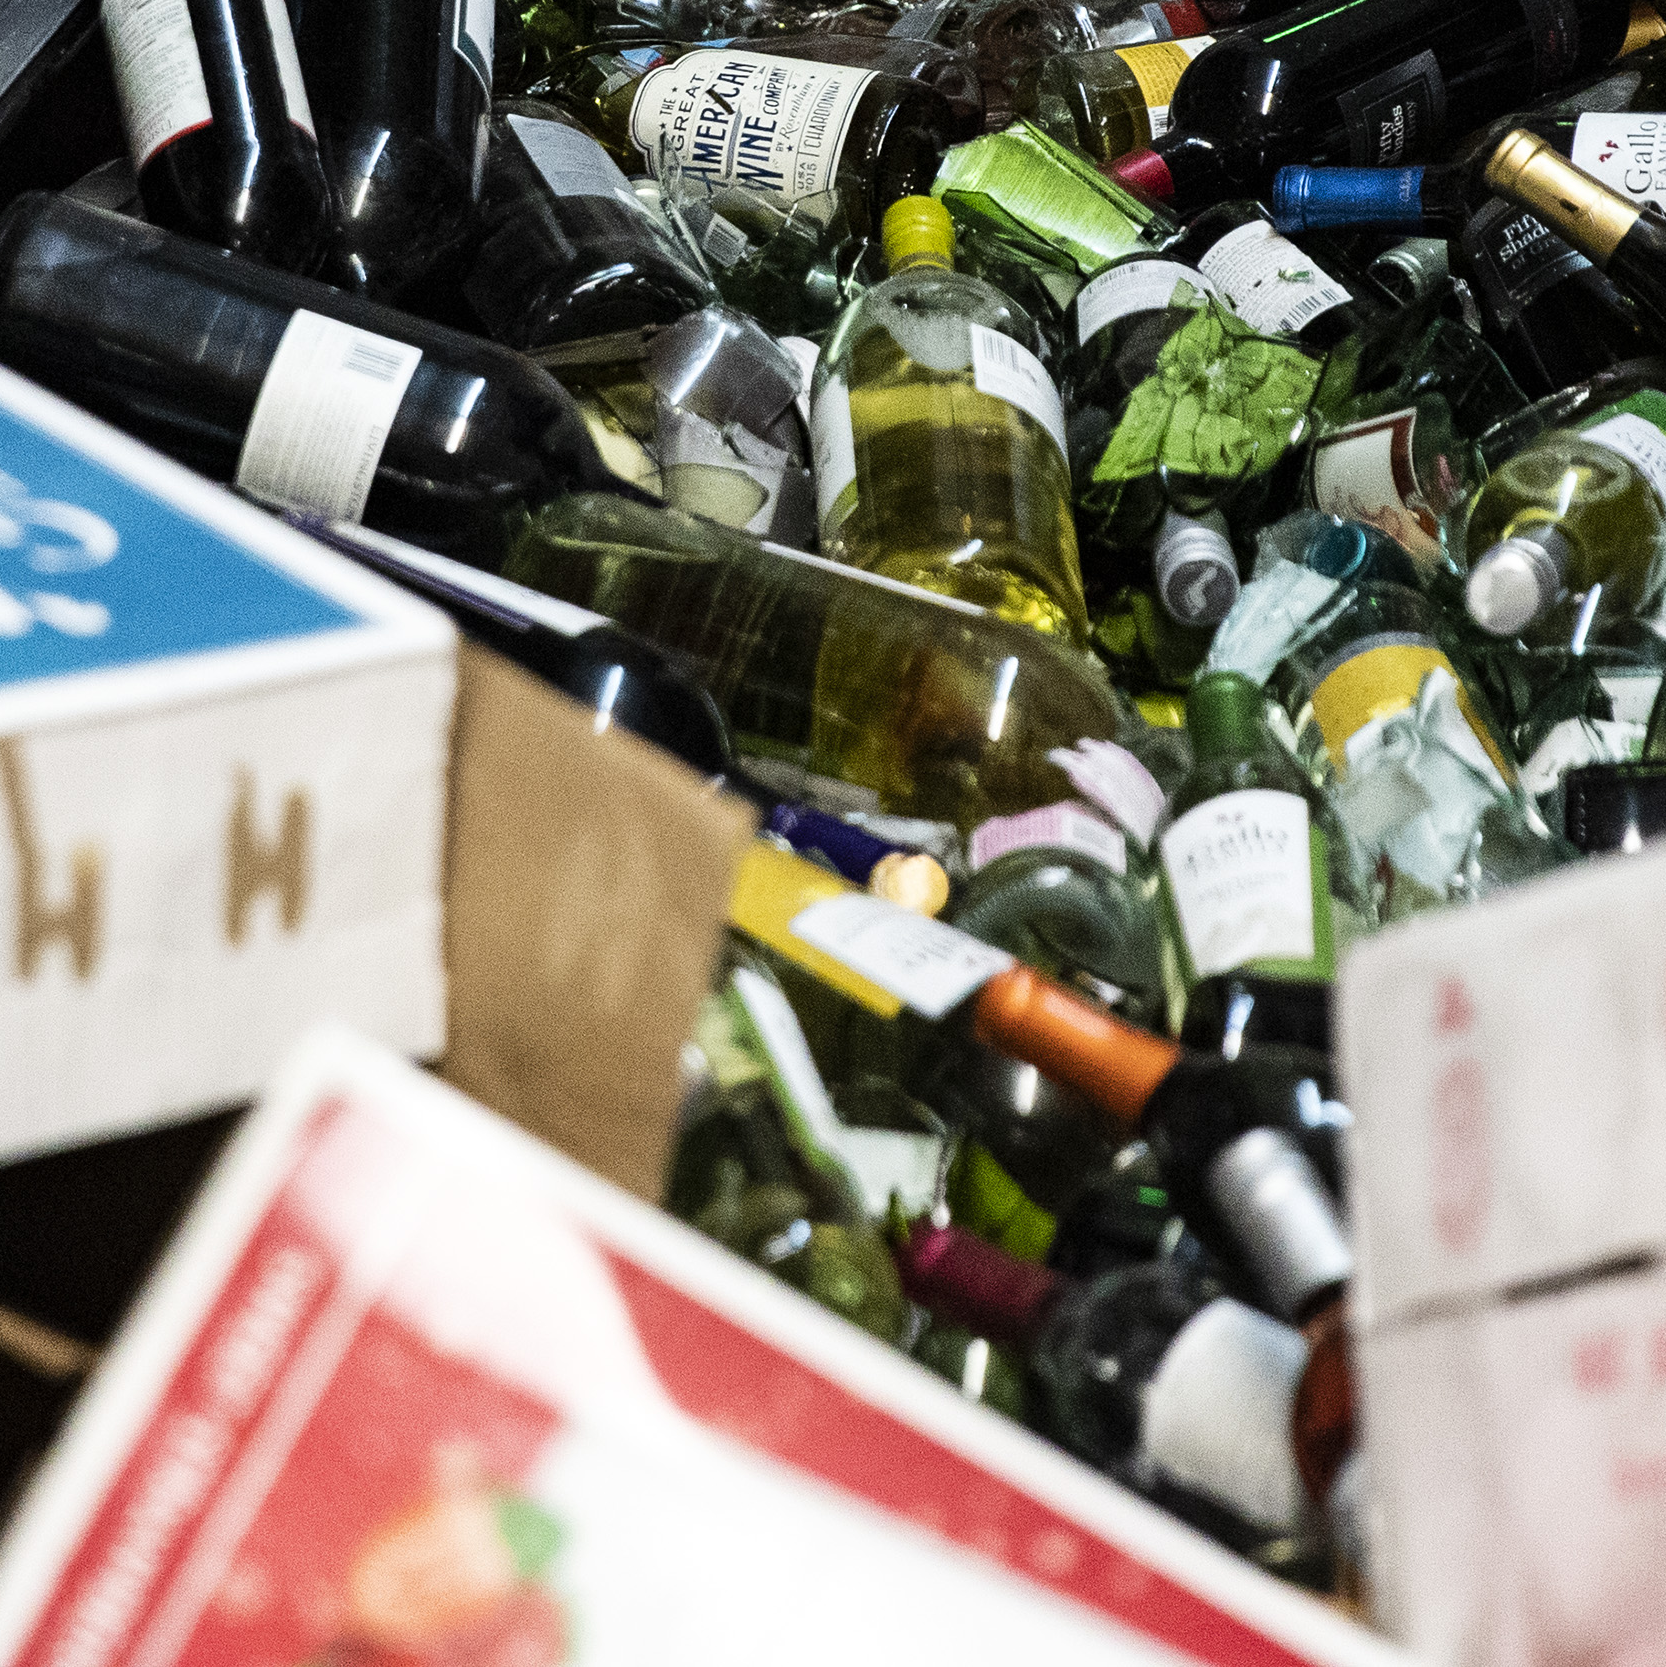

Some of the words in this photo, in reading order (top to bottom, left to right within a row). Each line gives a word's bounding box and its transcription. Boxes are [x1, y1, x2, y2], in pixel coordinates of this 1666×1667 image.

[659, 98, 676, 115] THE
[673, 73, 706, 152] GREAT
[680, 60, 759, 188] AMERCAN
[736, 116, 783, 191] WINE
[764, 67, 787, 116] COMPANY
[803, 79, 841, 150] CHARDONNAY
[775, 142, 785, 153] BY
[797, 161, 806, 190] USA
[807, 163, 817, 192] 2015
[1624, 120, 1658, 194] Gallo
